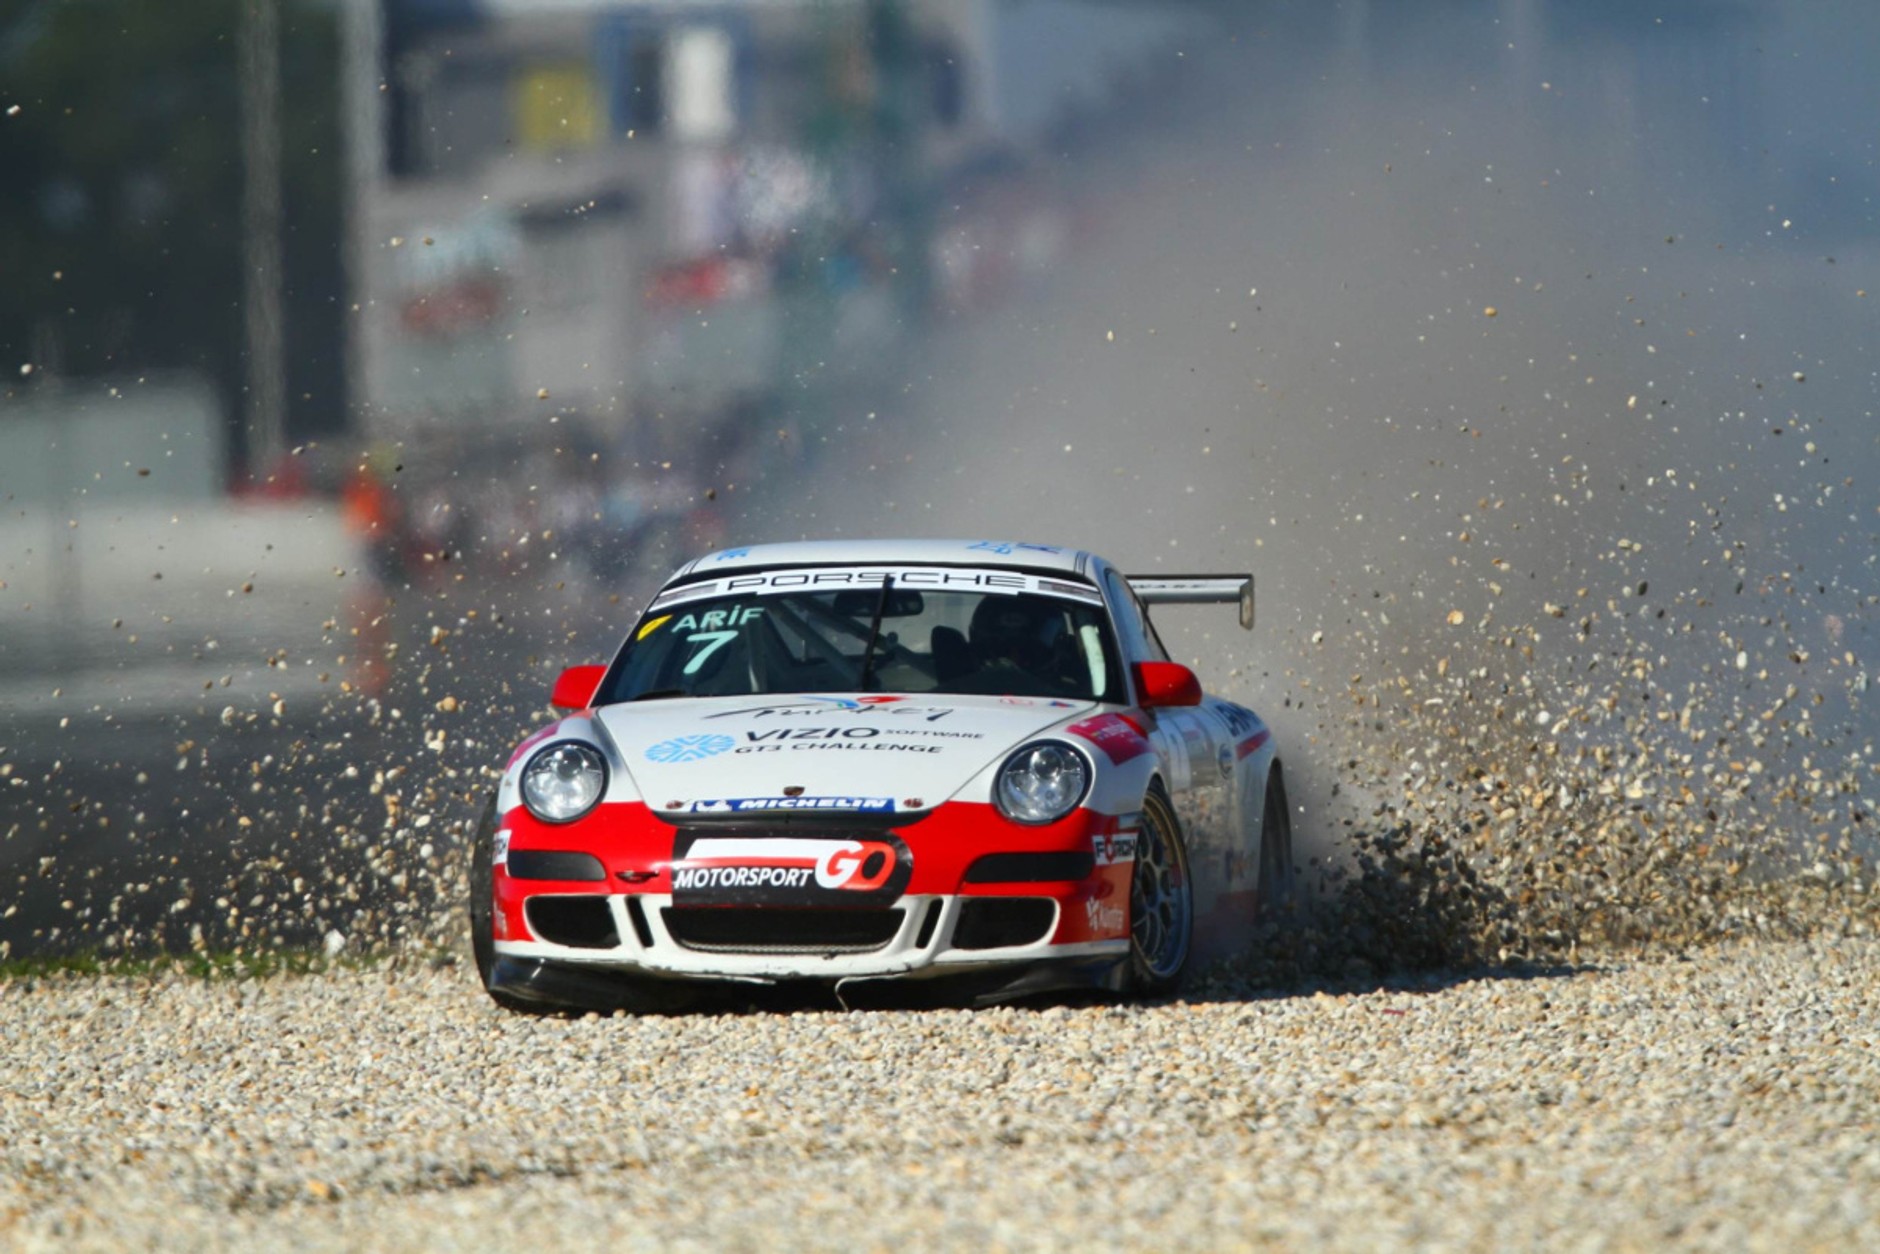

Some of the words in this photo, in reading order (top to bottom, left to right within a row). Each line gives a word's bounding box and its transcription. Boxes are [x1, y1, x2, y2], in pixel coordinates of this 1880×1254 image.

[728, 572, 1027, 591] PORSCHE
[683, 630, 739, 674] 7
[746, 727, 880, 742] VIZIO
[885, 728, 985, 740] SOFTWARE
[735, 744, 783, 754] GT3
[791, 742, 943, 754] CHALLENGE
[738, 798, 887, 808] MICHELIN
[815, 840, 896, 891] GO
[674, 866, 812, 889] MOTORSPORT
